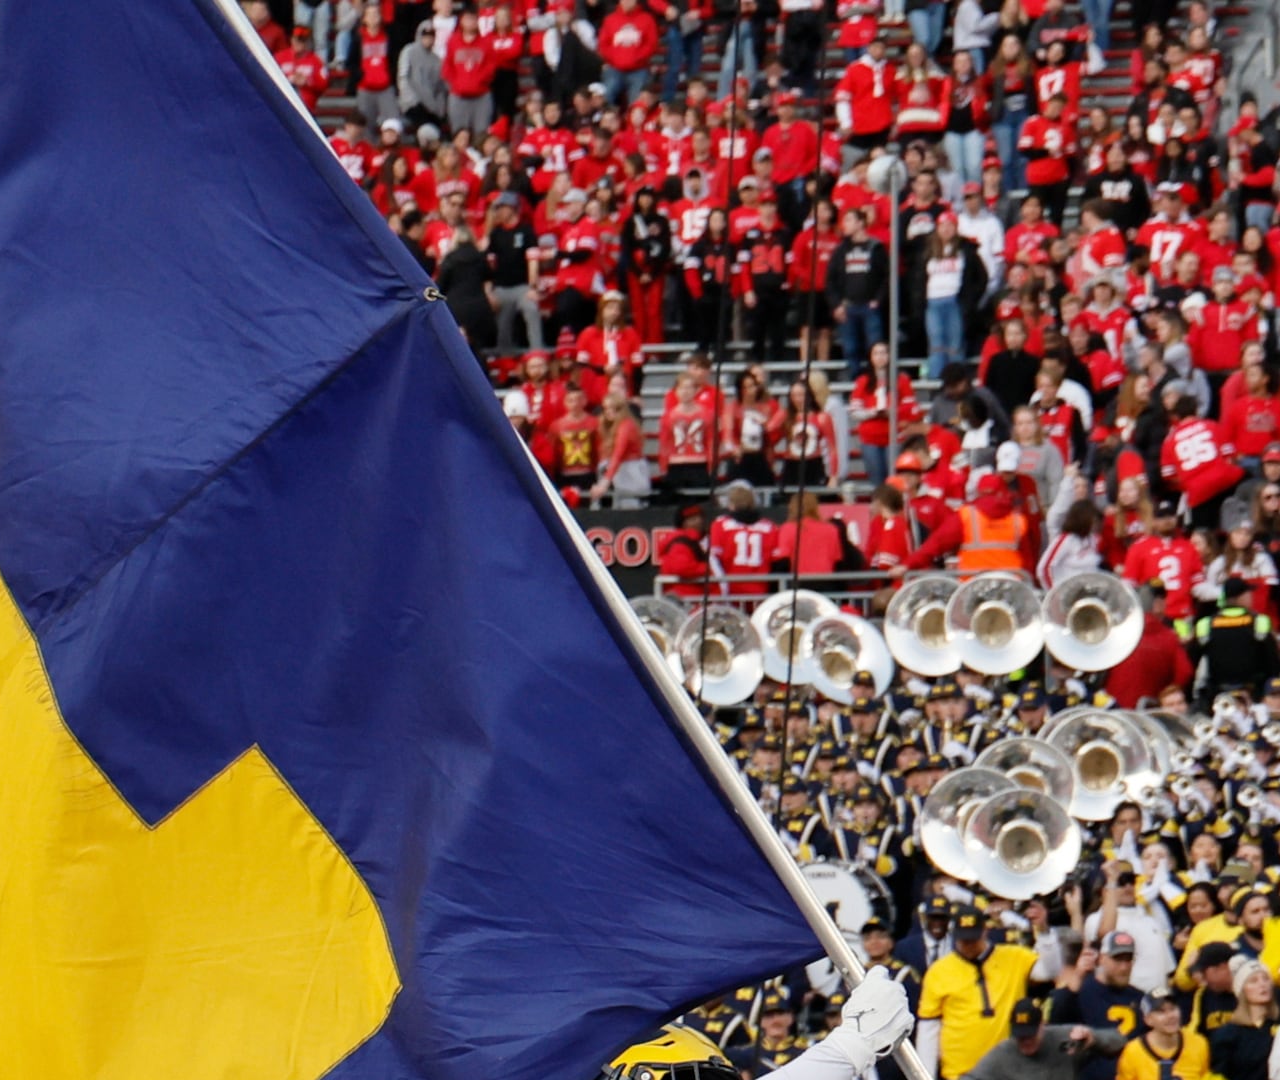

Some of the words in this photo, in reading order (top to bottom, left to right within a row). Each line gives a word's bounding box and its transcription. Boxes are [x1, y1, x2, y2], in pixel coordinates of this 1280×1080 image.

[1151, 229, 1184, 279] 17
[1175, 431, 1217, 470] 95
[734, 531, 762, 567] 11
[1159, 555, 1181, 590] 2
